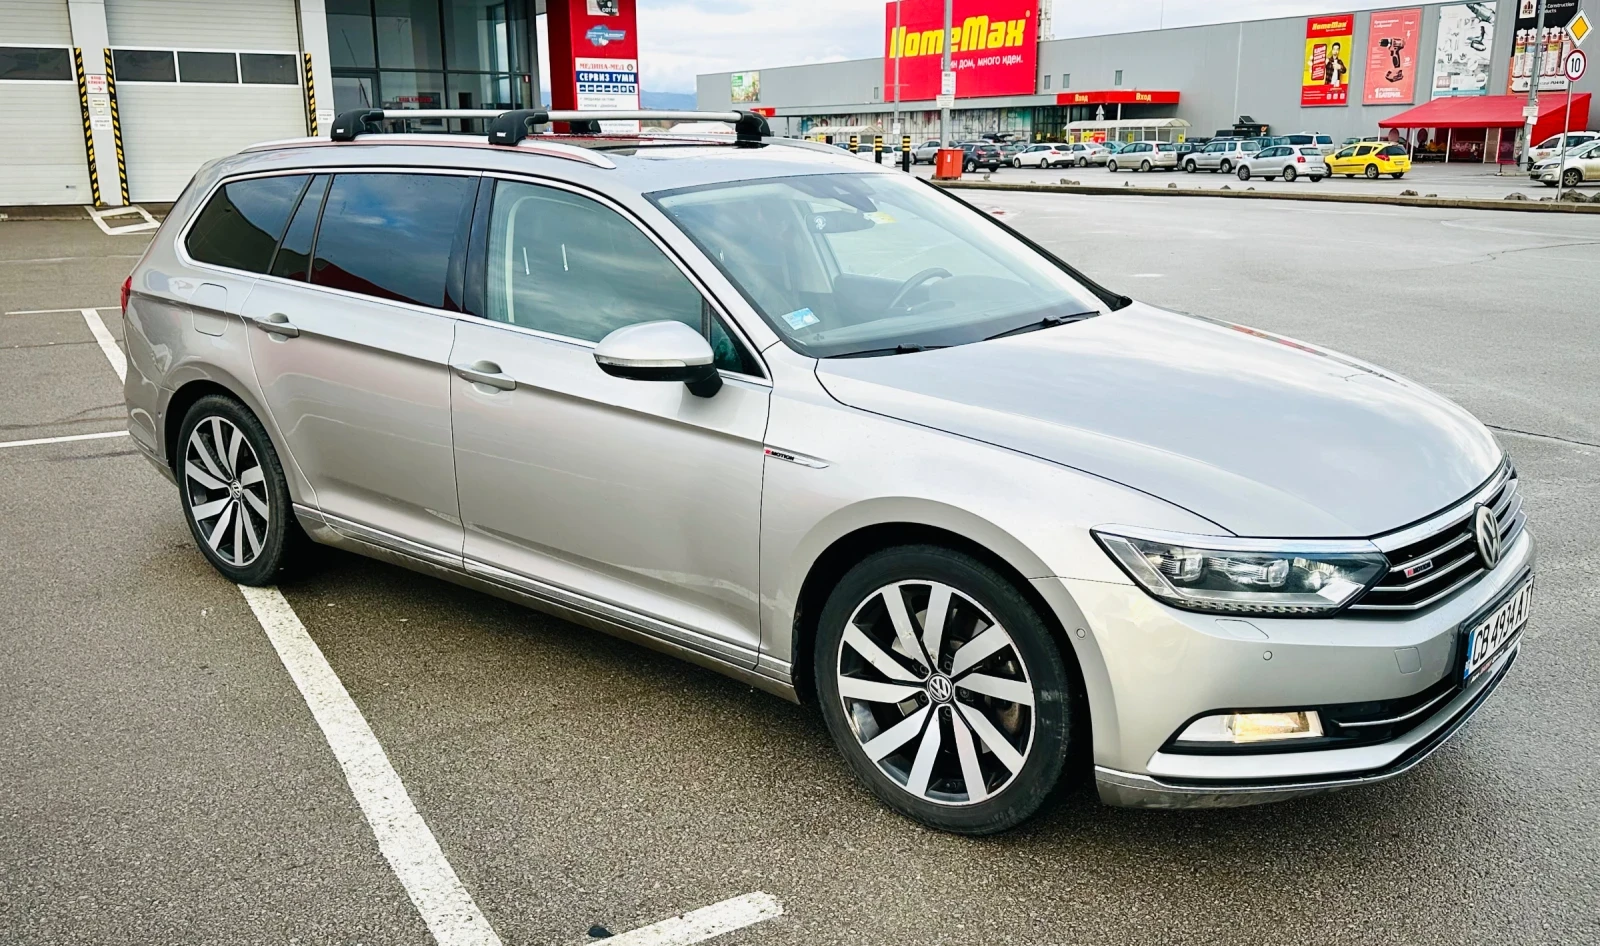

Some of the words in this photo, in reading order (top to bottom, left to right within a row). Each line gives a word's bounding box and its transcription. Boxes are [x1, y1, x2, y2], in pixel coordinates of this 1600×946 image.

[889, 15, 1026, 59] HomeMax
[579, 63, 625, 71] МЕДИНА-МЕД
[959, 59, 976, 70] дом,
[977, 55, 1001, 66] много
[1002, 54, 1024, 66] идеи.
[1571, 57, 1581, 73] 10
[579, 72, 610, 82] СЕРВИЗ
[612, 73, 635, 83] ГУМИ
[1074, 94, 1089, 103] Вход
[1136, 92, 1152, 102] Вход
[1472, 623, 1490, 666] CB
[1490, 598, 1517, 649] 4934
[1514, 583, 1532, 625] AT
